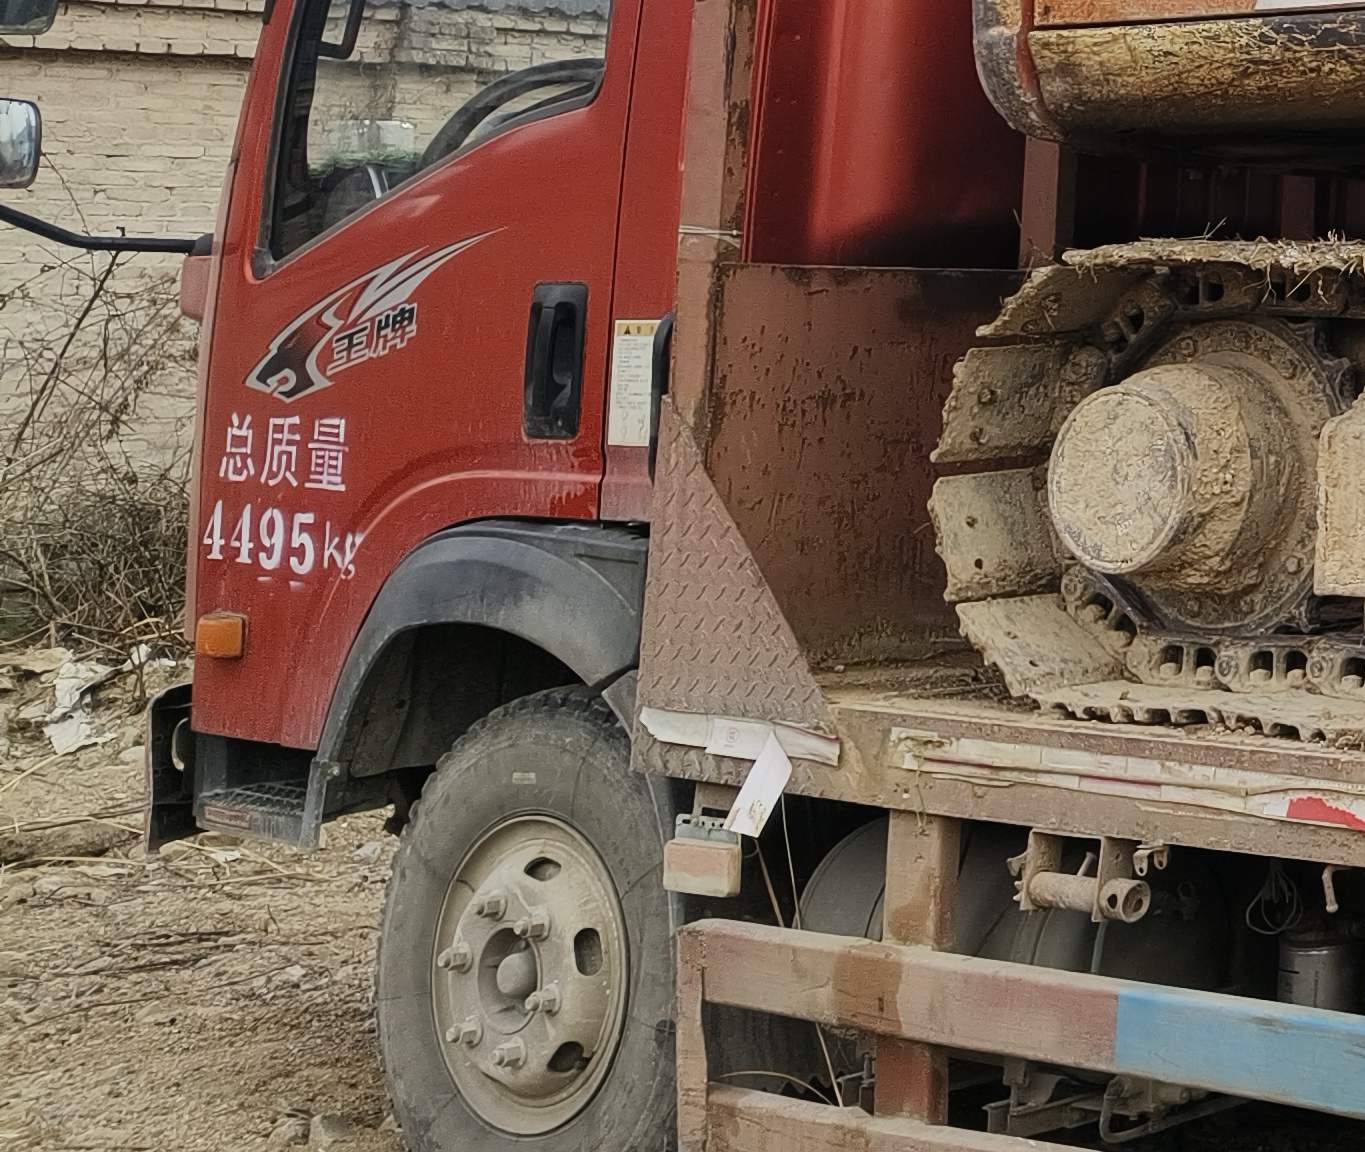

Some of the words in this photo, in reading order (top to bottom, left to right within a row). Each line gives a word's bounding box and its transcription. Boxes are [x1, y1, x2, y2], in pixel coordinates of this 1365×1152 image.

[327, 303, 417, 376] 王牌
[219, 411, 349, 492] 总质量
